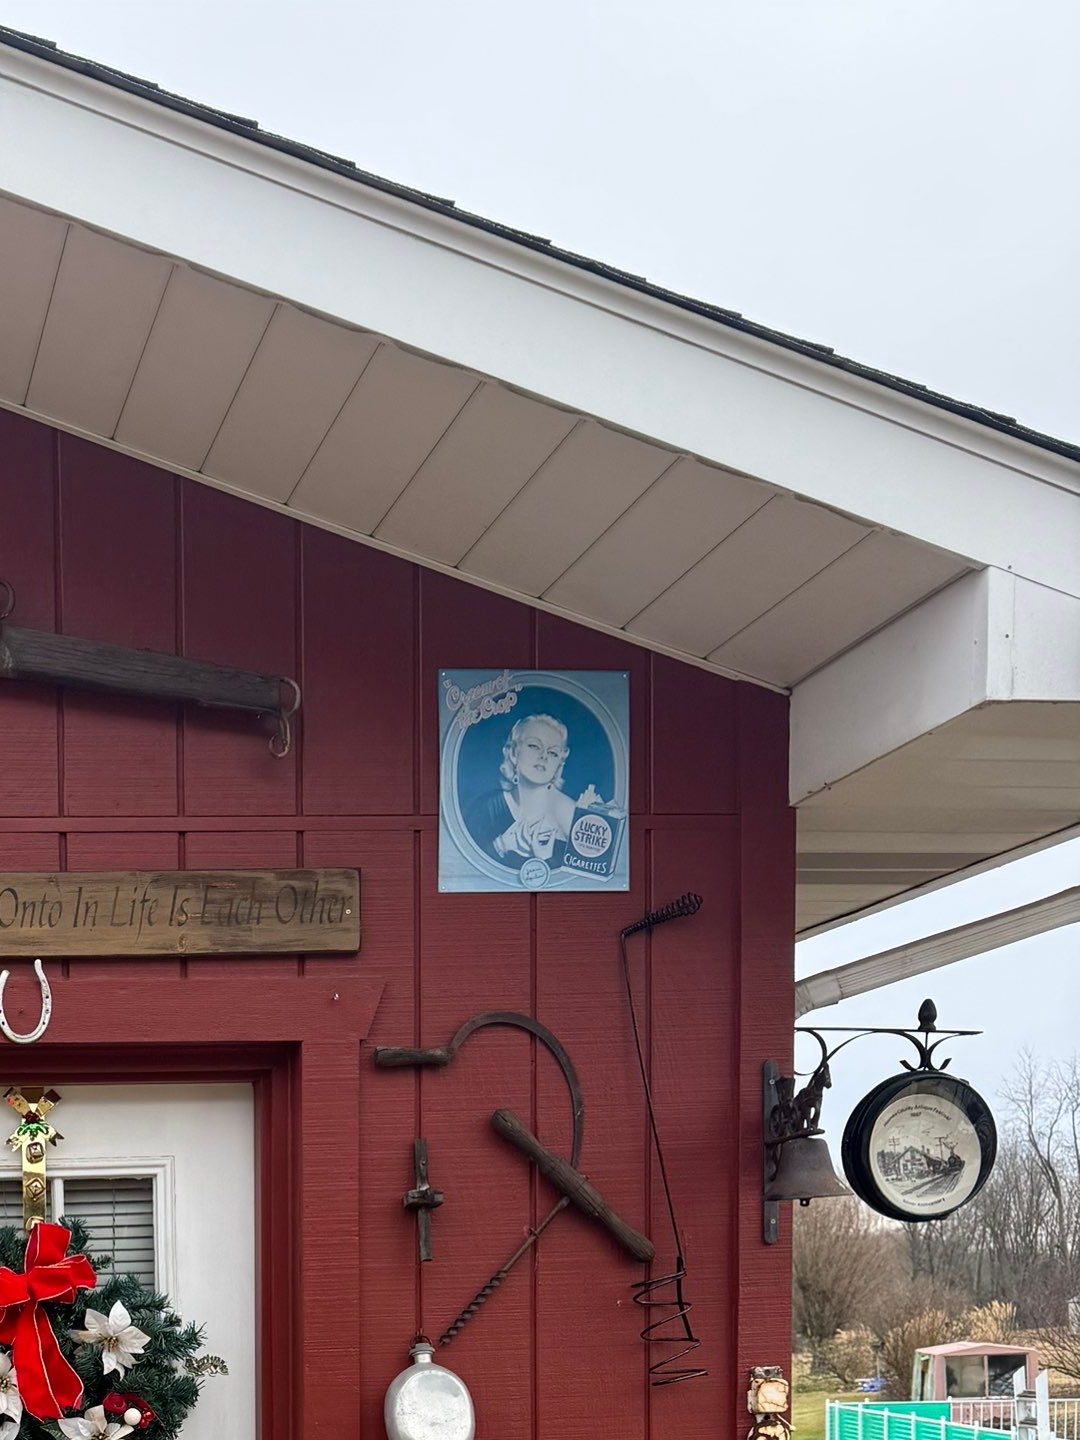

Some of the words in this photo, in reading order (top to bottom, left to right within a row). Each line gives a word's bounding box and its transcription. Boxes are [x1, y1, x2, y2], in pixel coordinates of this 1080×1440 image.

[580, 821, 608, 836] LUCKY
[574, 831, 608, 848] STRIKE
[564, 853, 607, 874] CIGARETTES
[72, 886, 99, 928] In
[109, 875, 164, 945] Life
[168, 884, 190, 928] Is
[199, 881, 263, 927] Each
[275, 880, 354, 925] Other
